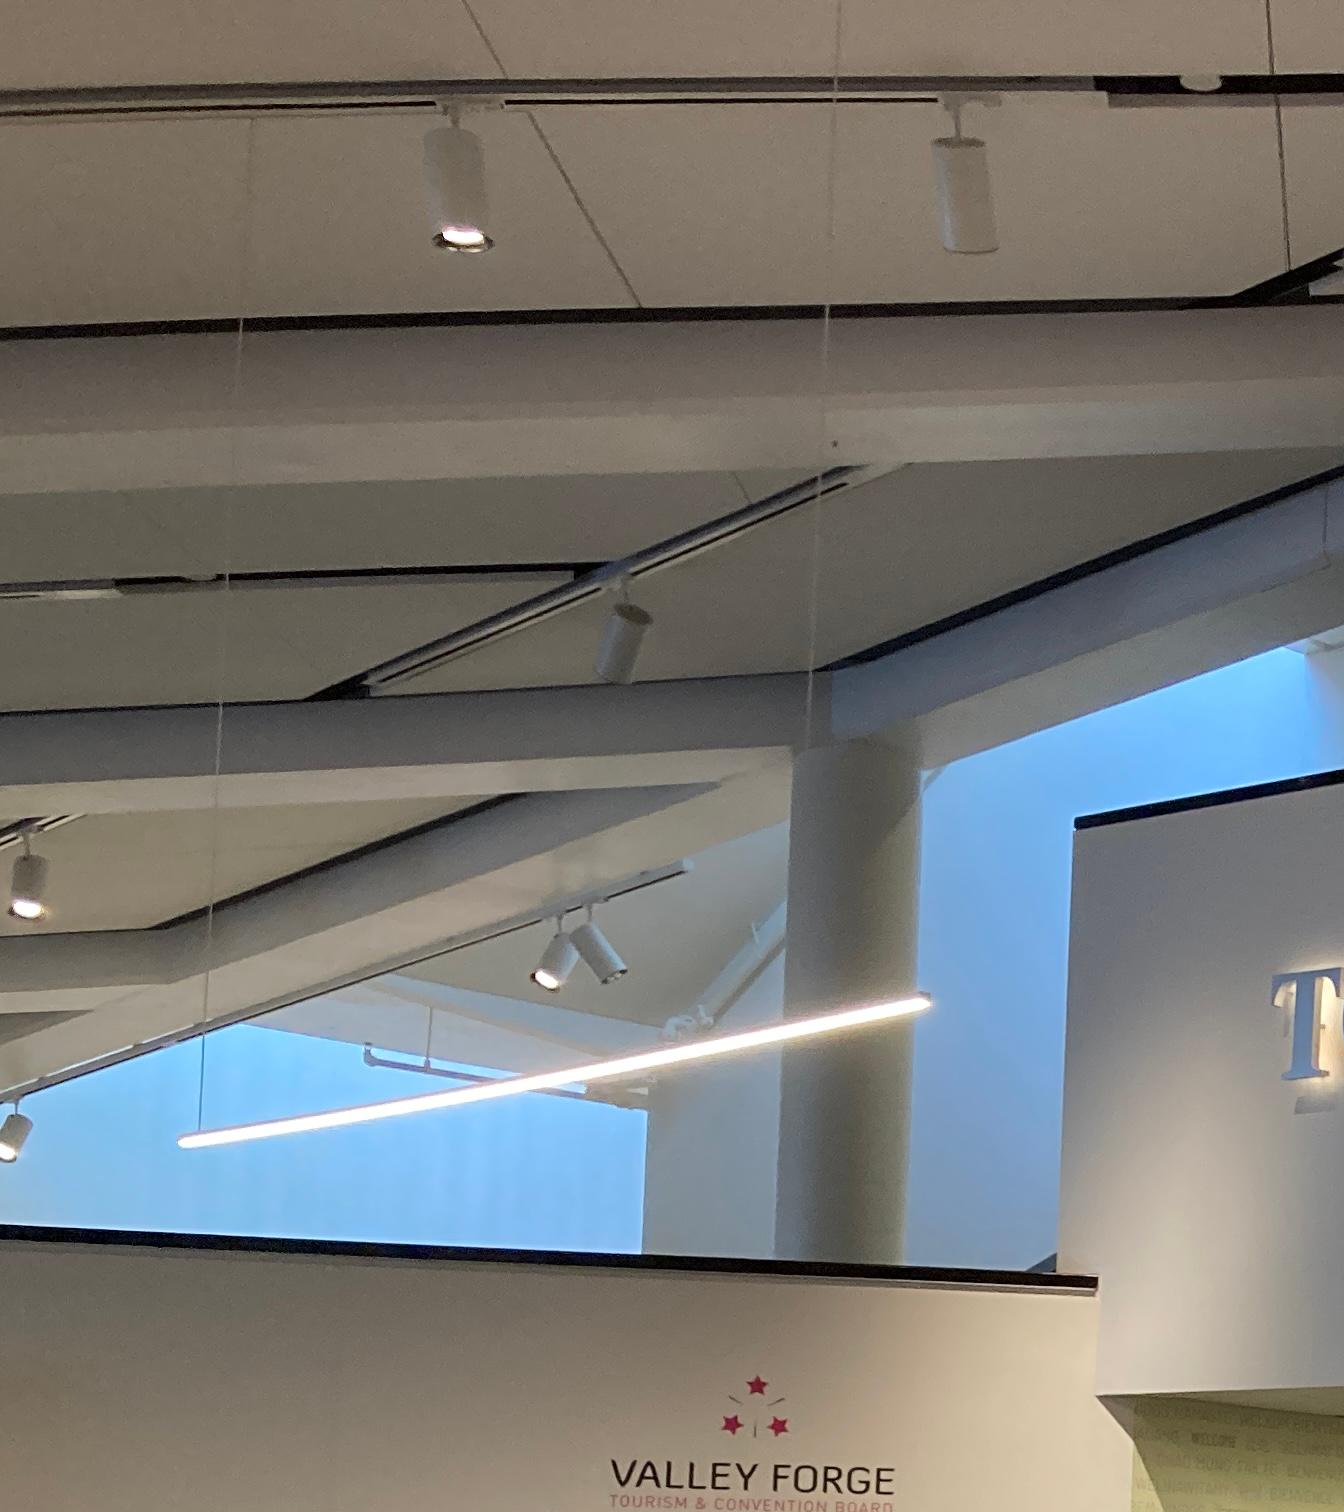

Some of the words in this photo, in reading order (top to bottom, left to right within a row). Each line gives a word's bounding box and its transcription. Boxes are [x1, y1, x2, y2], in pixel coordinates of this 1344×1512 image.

[611, 1459, 758, 1491] VALLEY
[773, 1465, 895, 1495] FORGE
[609, 1494, 688, 1509] TOURISM
[695, 1496, 705, 1509] &
